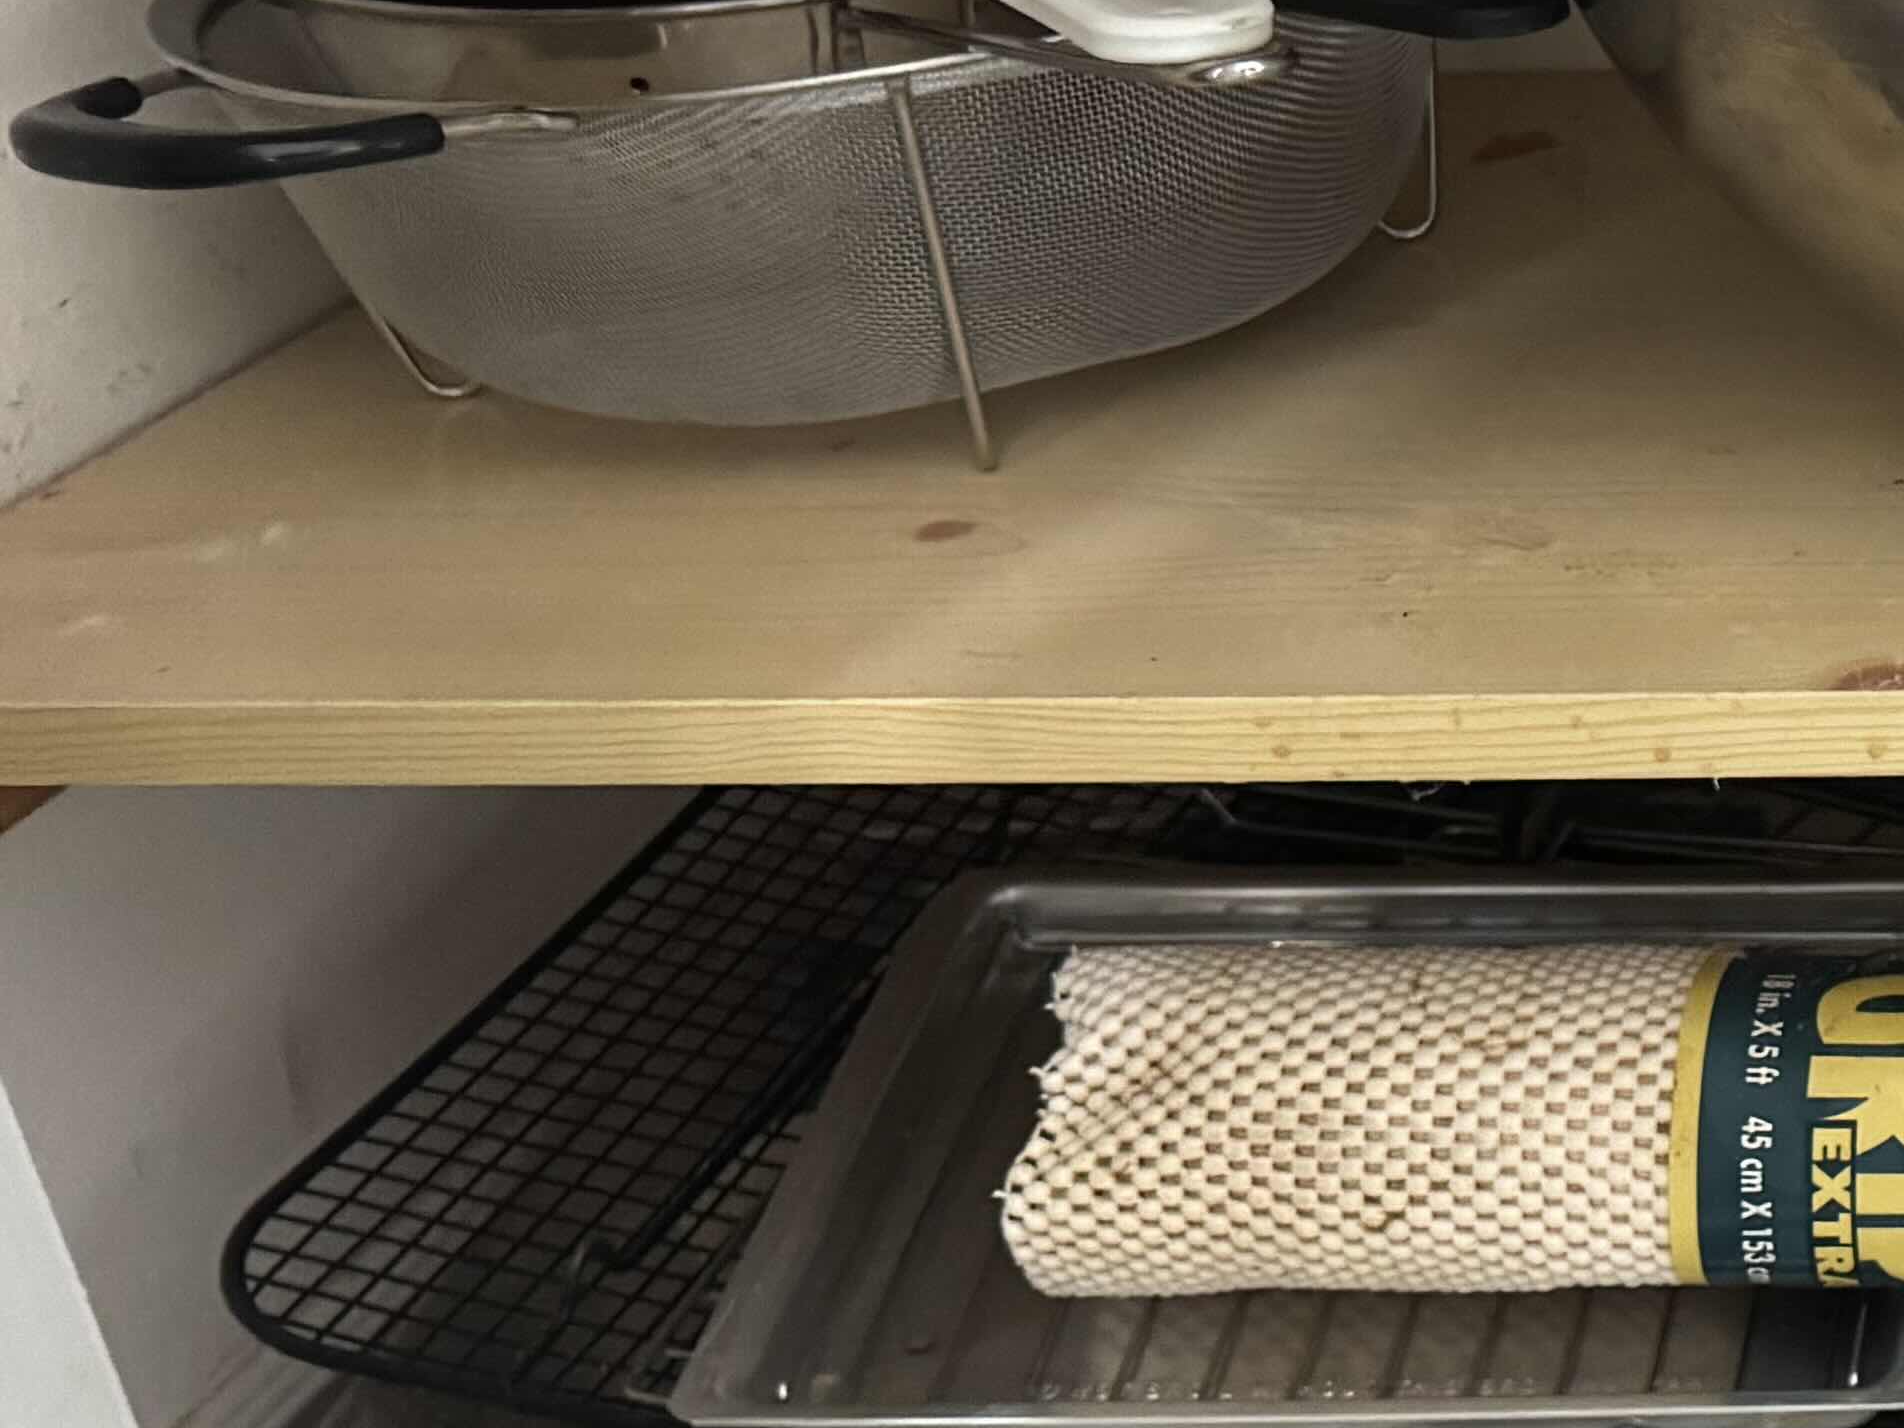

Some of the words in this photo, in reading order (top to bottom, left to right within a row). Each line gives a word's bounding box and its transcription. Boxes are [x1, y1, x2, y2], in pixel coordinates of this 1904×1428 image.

[1762, 974, 1797, 989] 18
[1755, 992, 1791, 1014] in.
[1750, 1020, 1784, 1037] X
[1747, 1044, 1780, 1059] 5
[1745, 1067, 1780, 1084] ft
[1741, 1116, 1773, 1149] 45
[1740, 1158, 1763, 1193] cm
[1740, 1200, 1773, 1219] X
[1812, 1128, 1859, 1287] EXTRA
[1742, 1228, 1776, 1263] 153
